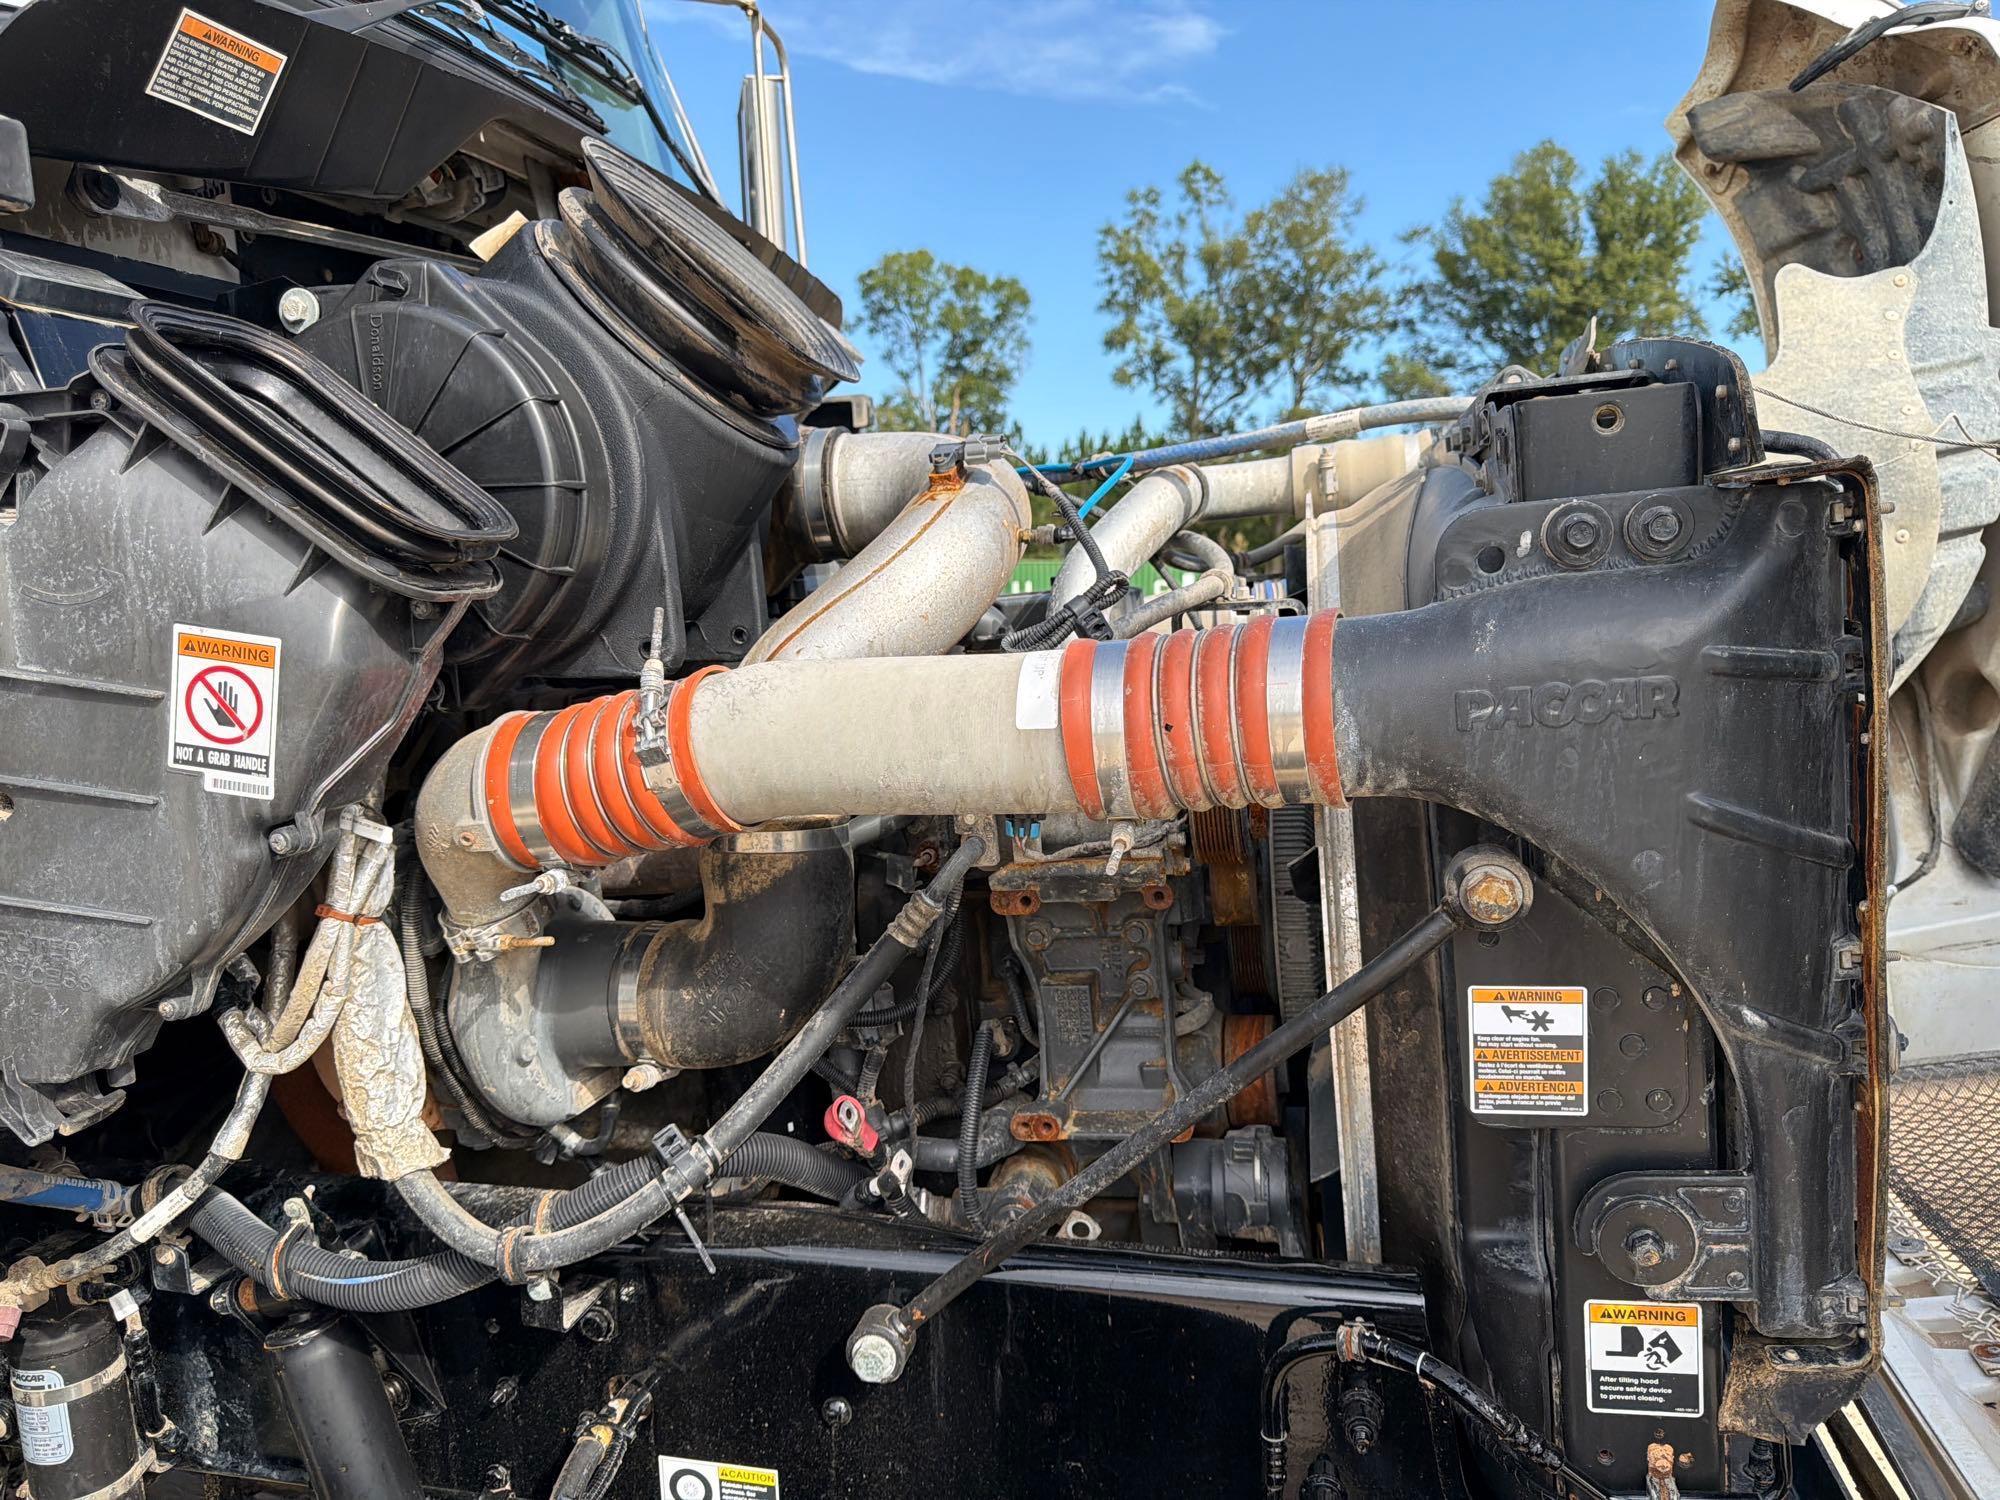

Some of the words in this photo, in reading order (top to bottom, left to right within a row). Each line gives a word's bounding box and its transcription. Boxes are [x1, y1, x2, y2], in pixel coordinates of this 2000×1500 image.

[176, 34, 190, 44] THIS
[189, 39, 210, 53] ENGINE
[215, 52, 244, 68] EQUIPPED
[243, 64, 257, 74] WITH
[257, 70, 266, 78] AN
[211, 32, 261, 62] WARNING
[169, 48, 189, 61] SPRAY
[188, 56, 207, 69] ETHER
[207, 65, 235, 81] STARTING
[234, 77, 248, 87] AIDS
[247, 82, 261, 92] INTO
[173, 41, 200, 57] ELECTRIC
[199, 53, 216, 64] INLET
[215, 60, 239, 74] HEATER.
[240, 71, 250, 79] DO
[248, 75, 261, 84] NOT
[159, 70, 181, 83] INJURY.
[181, 79, 194, 88] SEE
[193, 84, 214, 97] ENGINE
[162, 62, 170, 70] IN
[169, 65, 179, 74] AN
[178, 69, 210, 87] EXPLOSION
[209, 82, 222, 92] AND
[221, 88, 251, 104] PERSONAL
[166, 55, 177, 64] AIR
[176, 60, 203, 75] CLEANER
[202, 71, 211, 79] AS
[210, 75, 224, 84] THIS
[223, 80, 243, 93] COULD
[242, 89, 263, 102] RESULT
[156, 77, 188, 94] OPERATION
[188, 90, 212, 104] MANUAL
[211, 100, 224, 109] FOR
[223, 105, 256, 122] ADDITIONAL
[370, 312, 384, 391] Donaldson
[197, 640, 269, 663] WARNING
[1454, 675, 1681, 732] PACCAR
[176, 746, 193, 761] NOT
[197, 749, 204, 763] A
[208, 751, 230, 767] GRAB
[234, 754, 266, 772] HANDLE
[1508, 991, 1562, 1001] WARNING
[1492, 1050, 1580, 1061] AVERTISSEMENT
[1498, 1081, 1575, 1093] ADVERTENCIA
[1613, 1309, 1686, 1321] WARNING
[1600, 1384, 1624, 1392] secure
[1609, 1393, 1636, 1401] prevent
[1637, 1395, 1665, 1403] closing.
[729, 1470, 774, 1482] CAUTION
